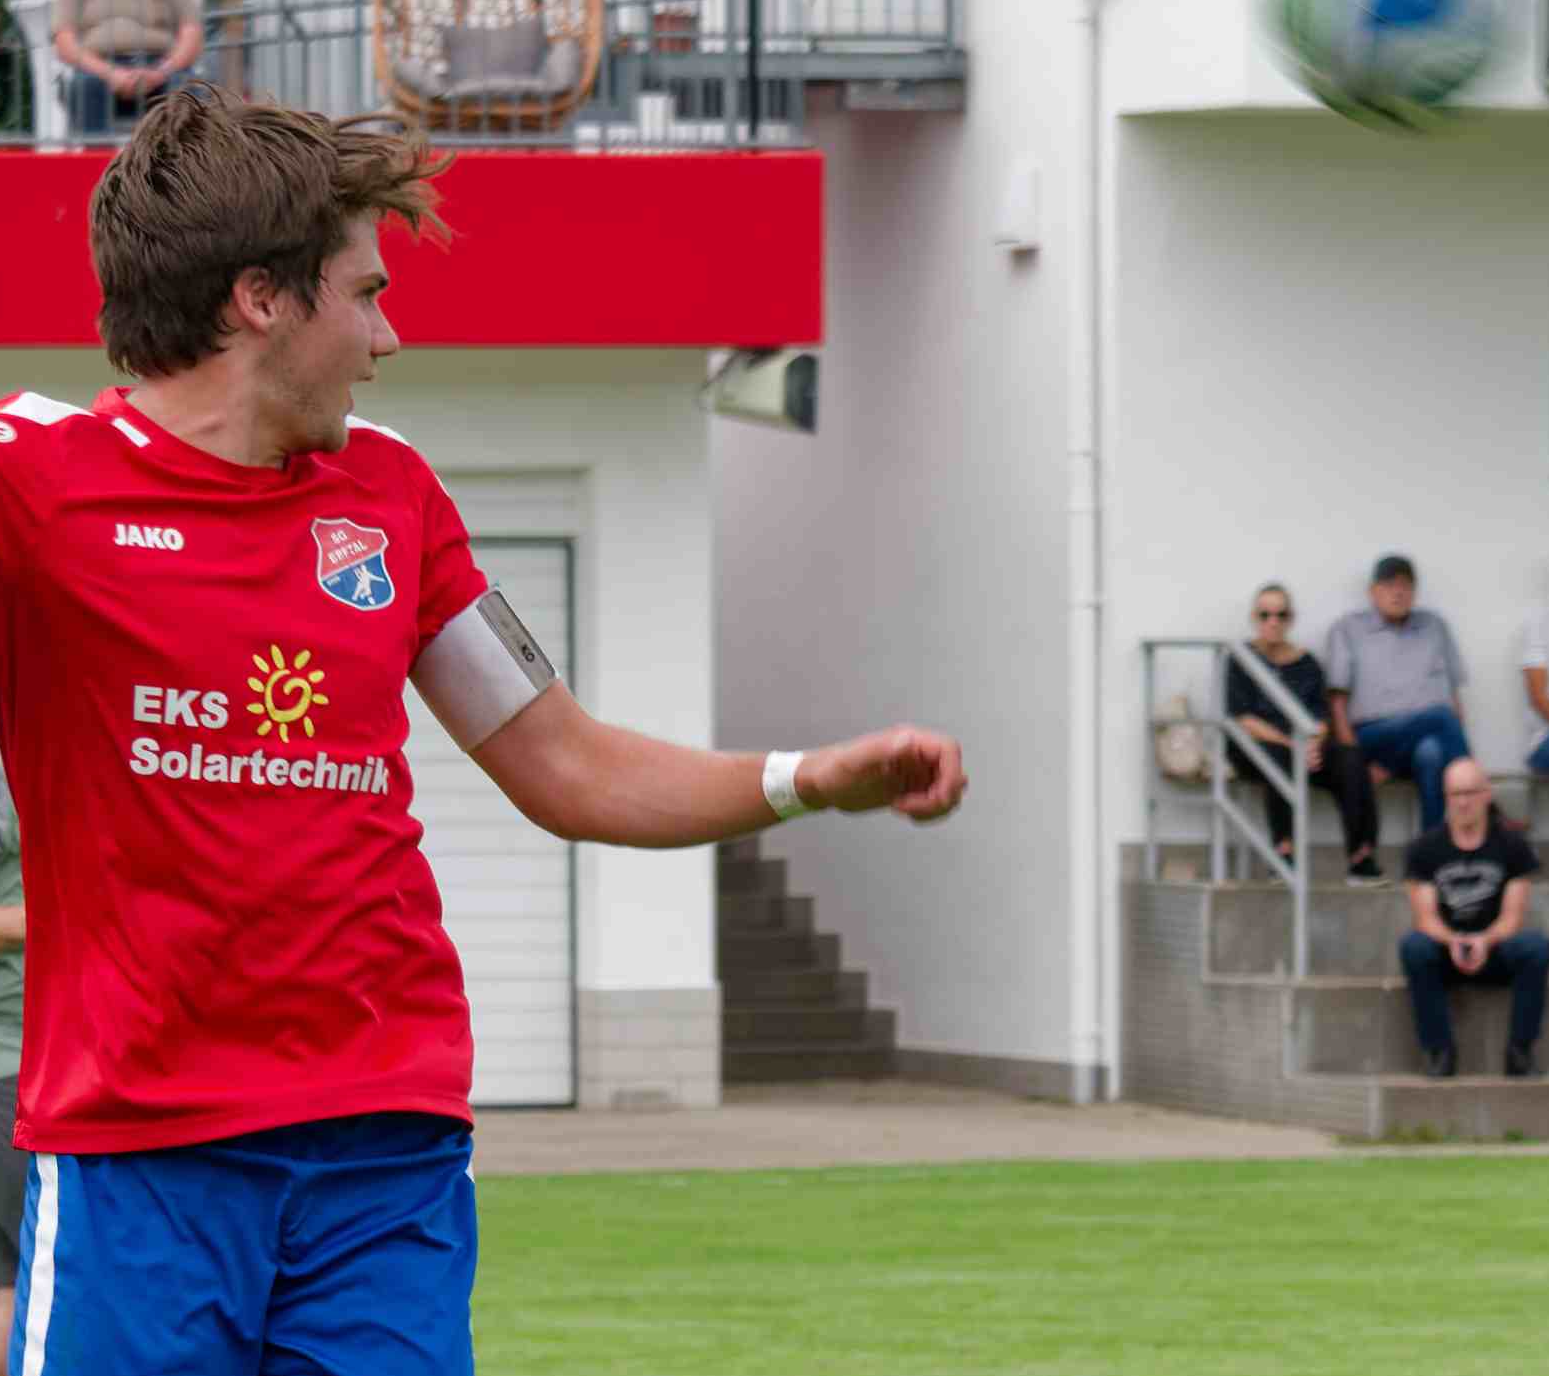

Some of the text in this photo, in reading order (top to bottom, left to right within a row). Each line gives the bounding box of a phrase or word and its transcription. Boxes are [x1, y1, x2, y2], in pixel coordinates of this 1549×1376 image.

[113, 523, 185, 551] JAKO
[133, 685, 229, 729] EKS
[129, 736, 389, 796] Solartechnik
